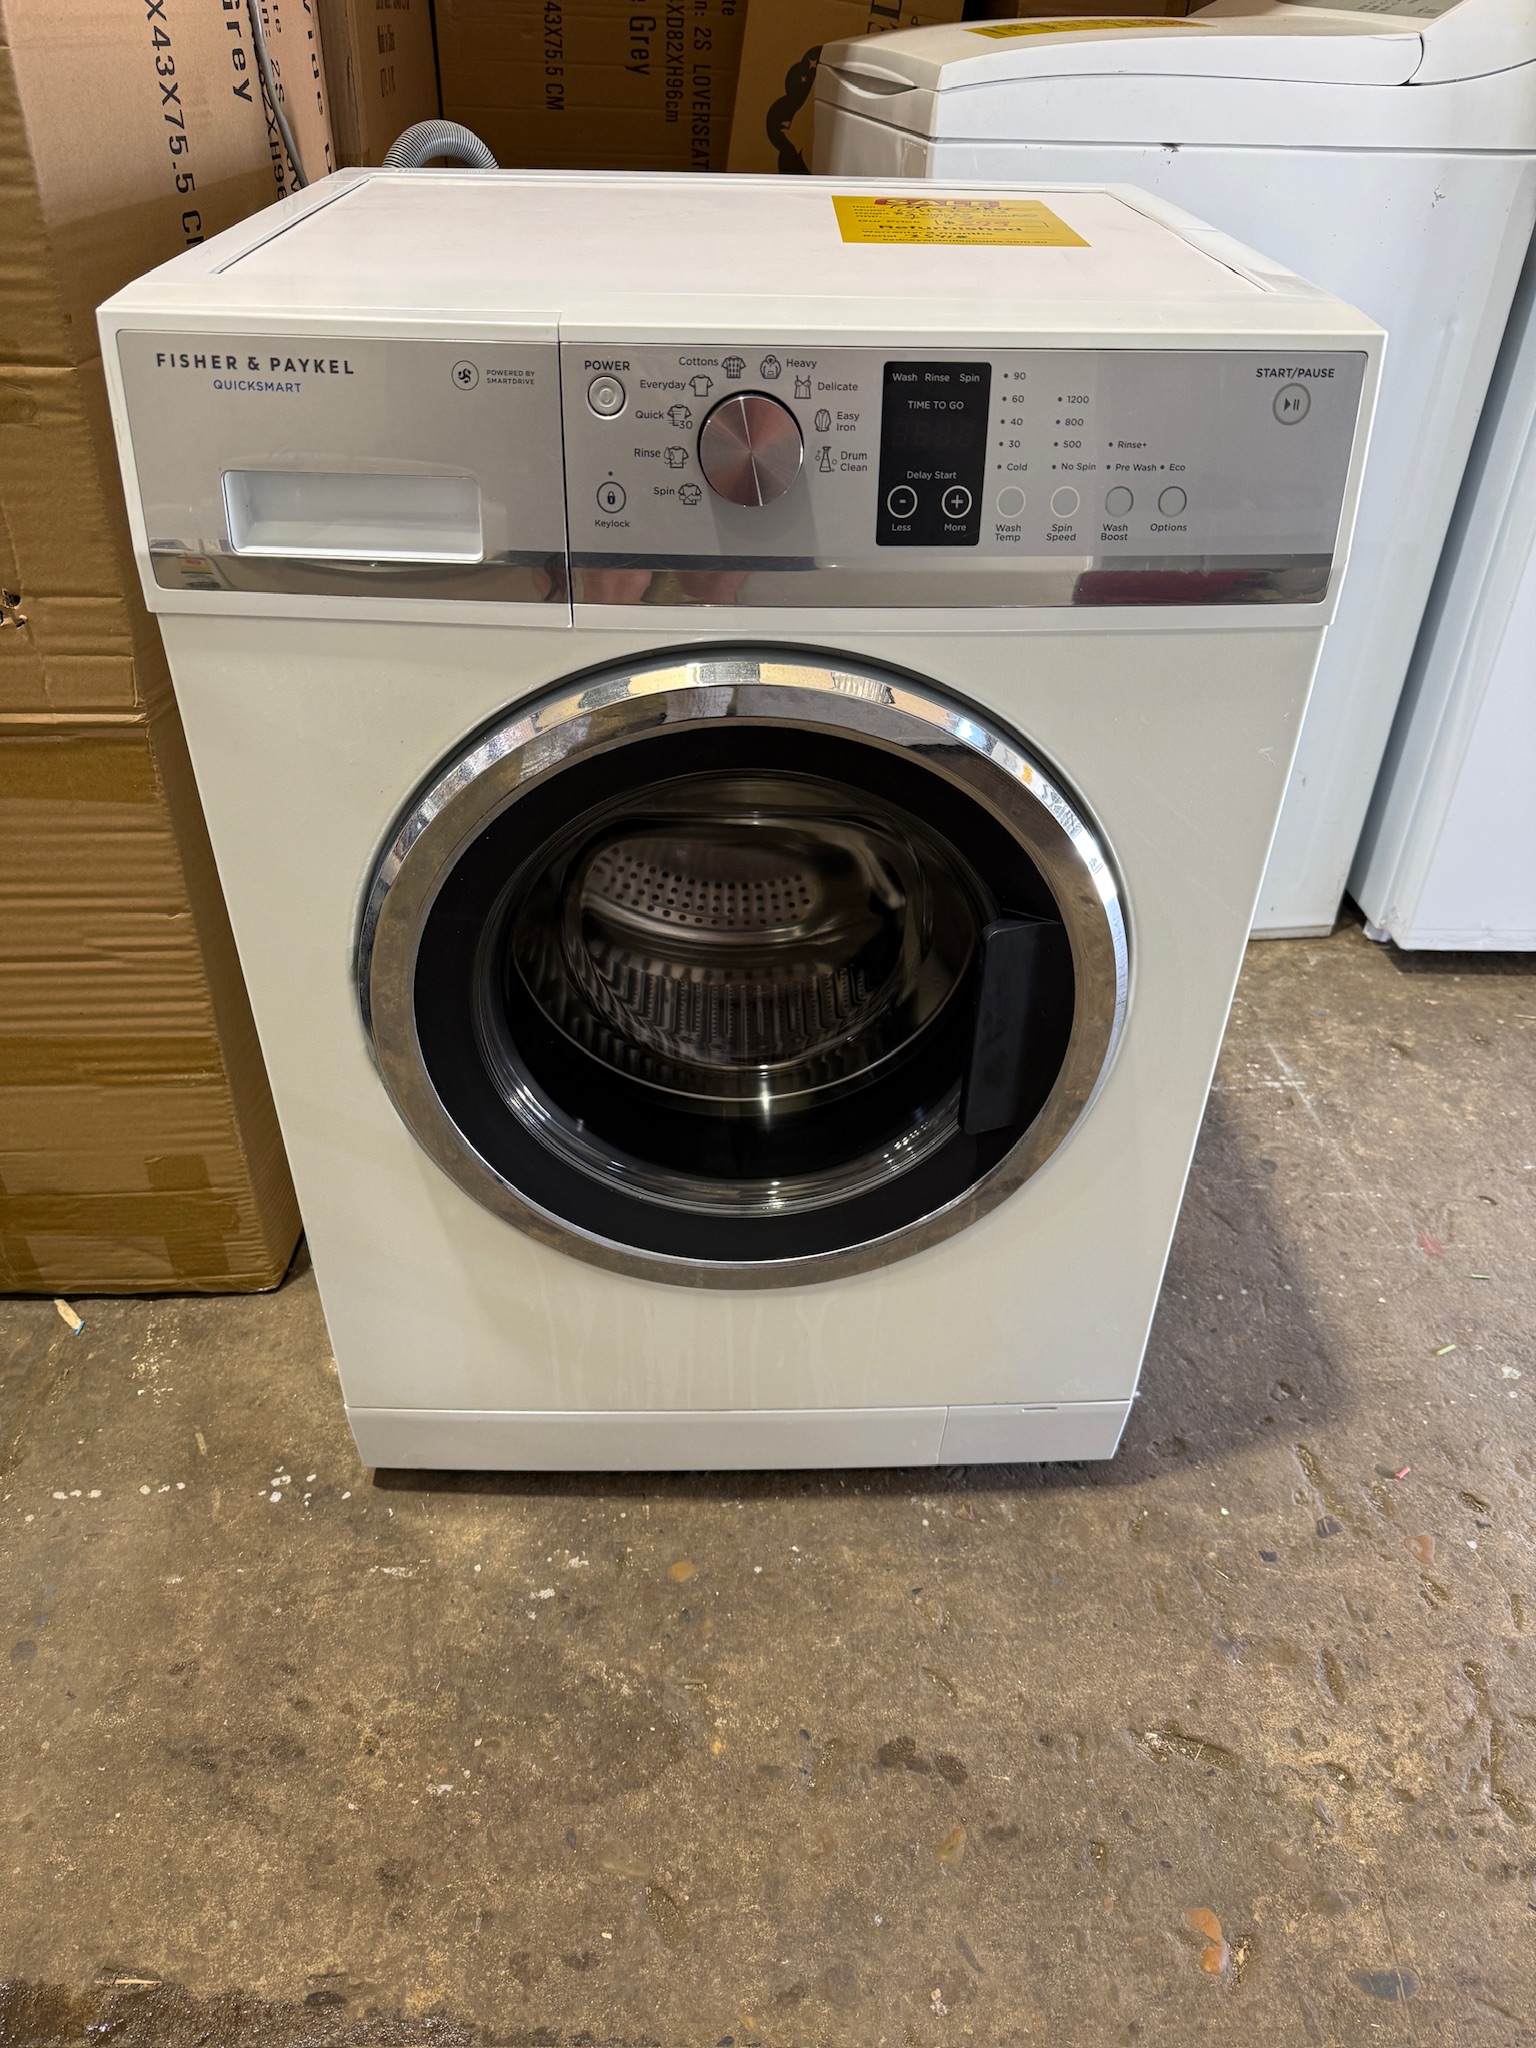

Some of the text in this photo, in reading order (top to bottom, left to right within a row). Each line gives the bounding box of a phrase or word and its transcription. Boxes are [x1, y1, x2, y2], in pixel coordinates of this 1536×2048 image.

[693, 26, 712, 51] 2S
[624, 16, 657, 75] Grey
[664, 0, 684, 123] XD82XH96cm
[545, 83, 565, 111] CM
[691, 64, 712, 170] LOVERSEAT
[156, 352, 354, 374] FISHER & PAYKEL
[584, 360, 630, 370] POWER
[678, 356, 718, 366] Cottons
[786, 358, 818, 370] Heavy
[892, 372, 980, 384] Wash Rinse Spin
[1014, 372, 1026, 380] 90
[1256, 366, 1336, 380] START/PAUSE
[214, 380, 302, 392] QUICKSMART
[486, 378, 534, 386] SMARTDRIVE
[640, 380, 686, 390] Everyday
[818, 382, 858, 392] Delicate
[1012, 394, 1024, 404] 60
[1068, 396, 1090, 404] 1200
[908, 400, 964, 410] TIME TO GO
[636, 410, 693, 430] Quick 30
[836, 412, 860, 422] Easy
[1010, 418, 1024, 426] 40
[1064, 418, 1084, 426] 800
[836, 422, 856, 432] Iron
[1008, 440, 1020, 448] 30
[1062, 440, 1082, 448] 500
[1118, 440, 1148, 448] Rinse+
[634, 448, 660, 458] Rinse
[840, 450, 868, 460] Drum
[840, 462, 868, 472] Clean
[1006, 462, 1028, 472] Cold
[1060, 462, 1096, 472] No Spin
[1116, 464, 1156, 472] Pre Wash
[1170, 464, 1186, 472] Eco
[906, 470, 956, 480] Delay Start
[654, 486, 676, 496] Spin
[594, 520, 630, 528] Keylock
[892, 524, 912, 532] Less
[944, 524, 966, 532] More
[996, 524, 1022, 532] Wash
[1052, 524, 1072, 534] Spin
[1102, 524, 1128, 532] Wash
[1150, 522, 1188, 532] Options
[994, 532, 1020, 542] Temp
[1046, 532, 1076, 542] Speed
[1100, 532, 1128, 540] Boost
